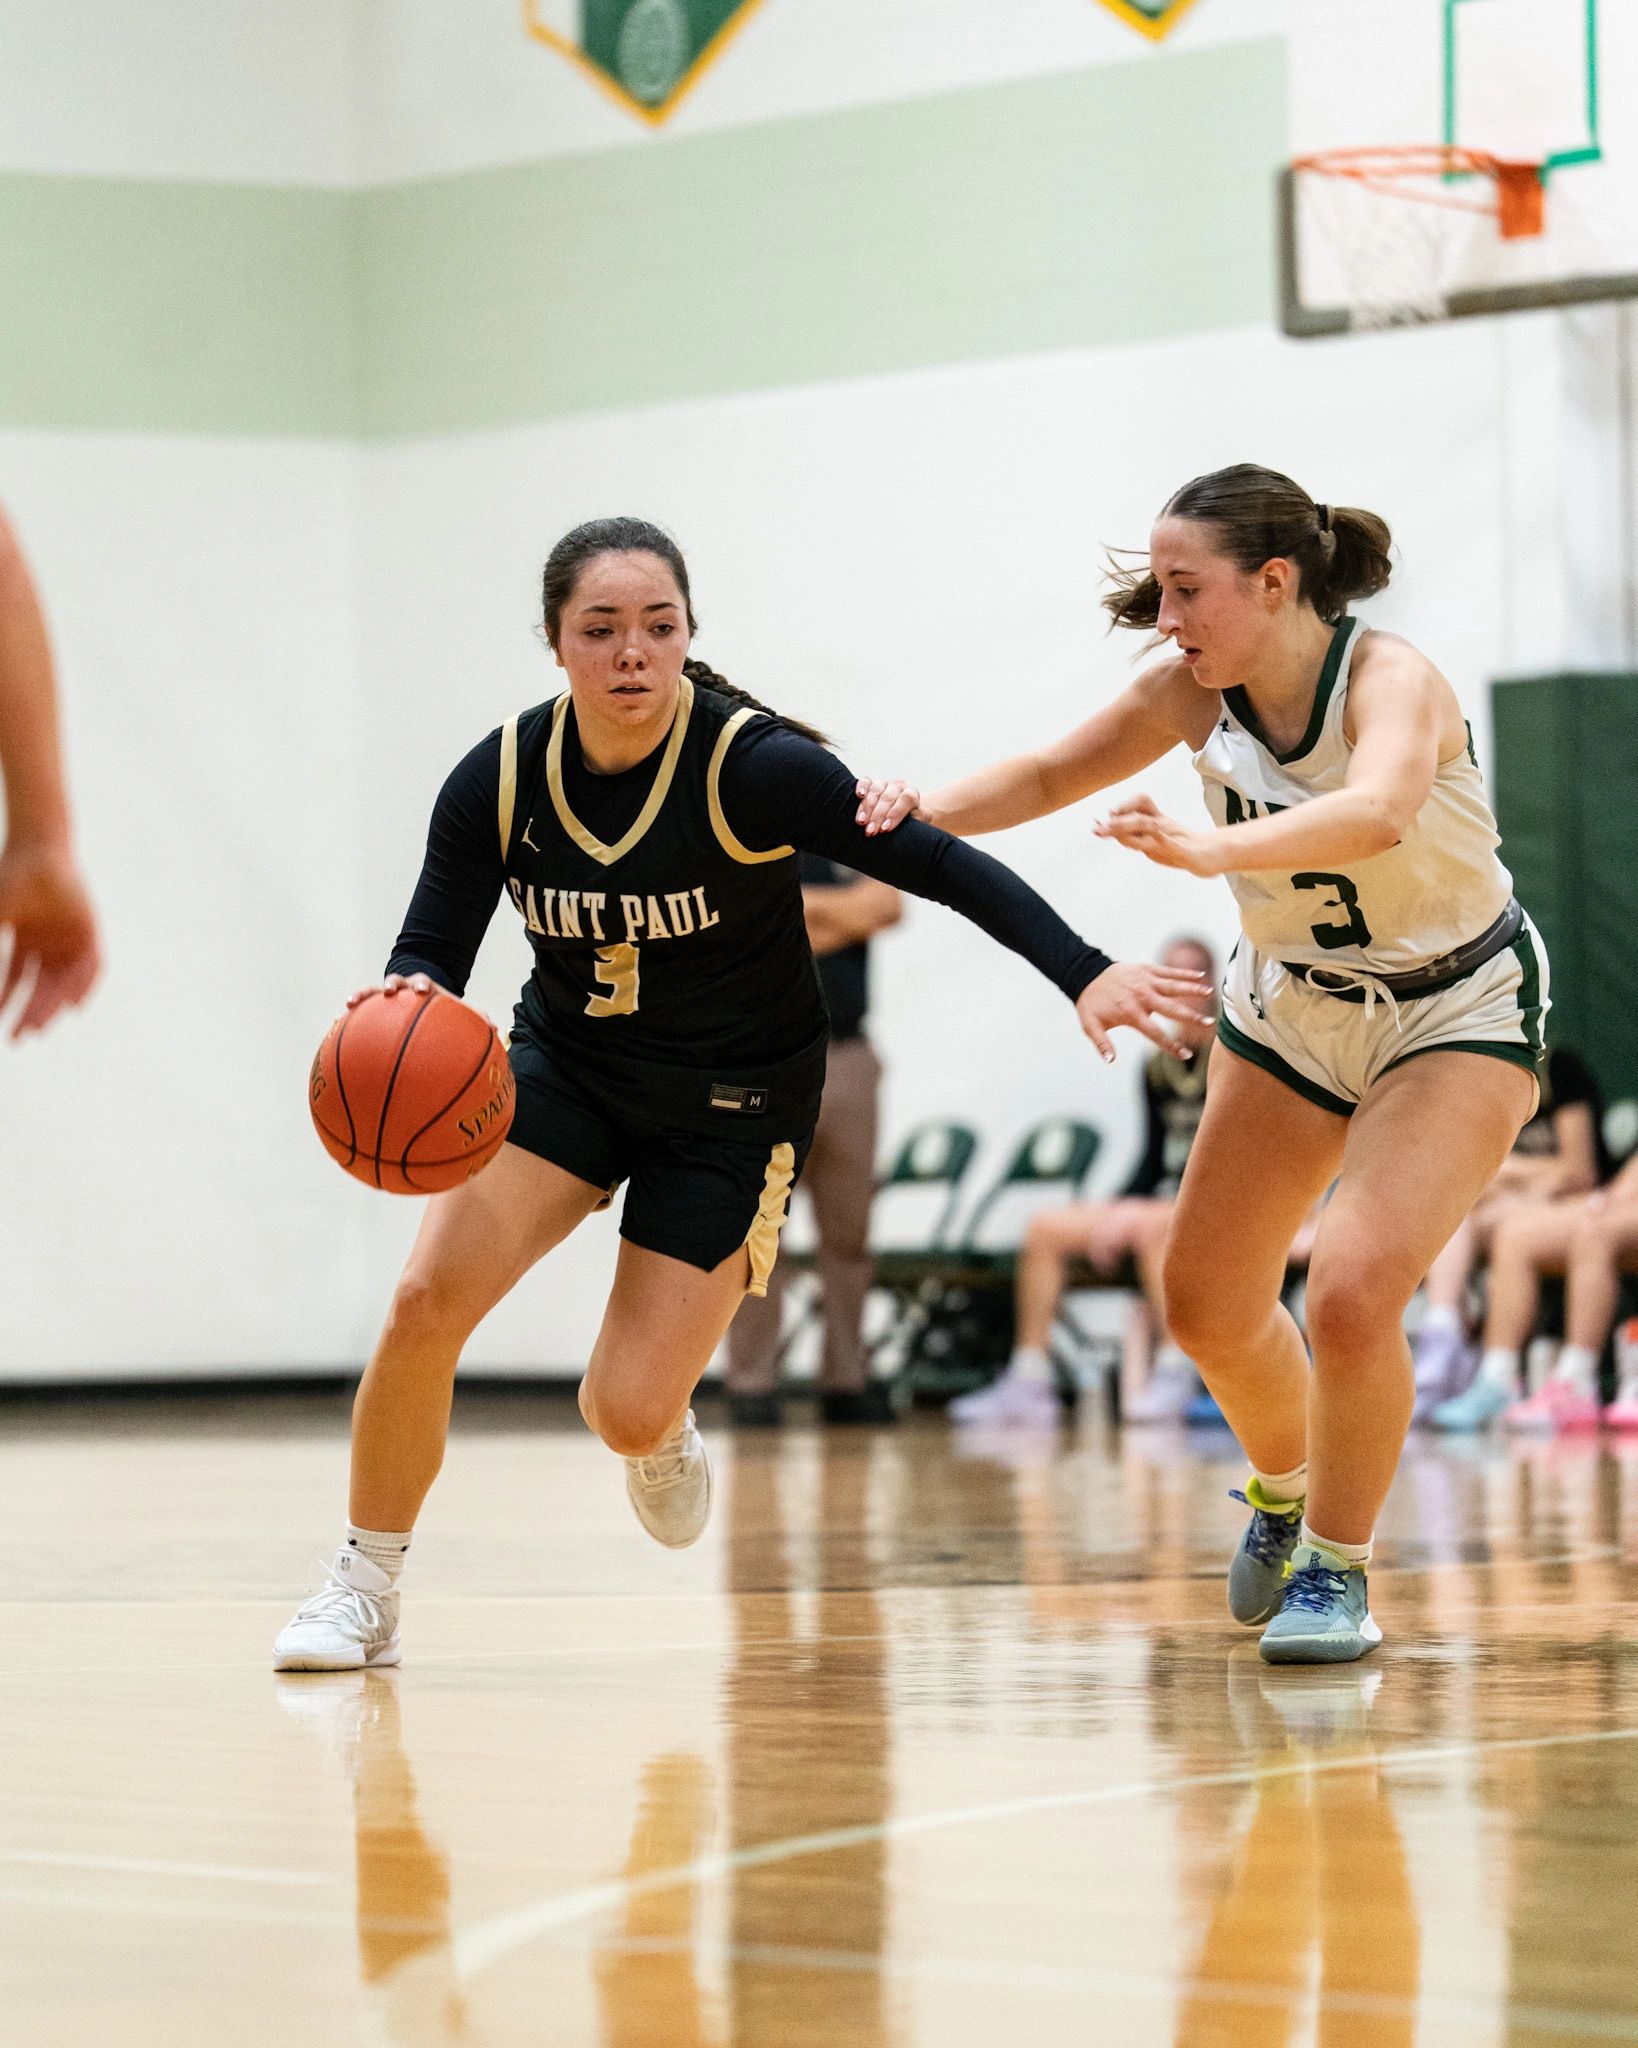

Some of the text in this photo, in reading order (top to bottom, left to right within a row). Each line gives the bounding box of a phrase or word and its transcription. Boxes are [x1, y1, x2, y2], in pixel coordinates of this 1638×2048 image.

[509, 876, 720, 942] SAINT PAUL
[1290, 872, 1372, 950] 3
[584, 941, 641, 1018] 3
[750, 1095, 761, 1107] M
